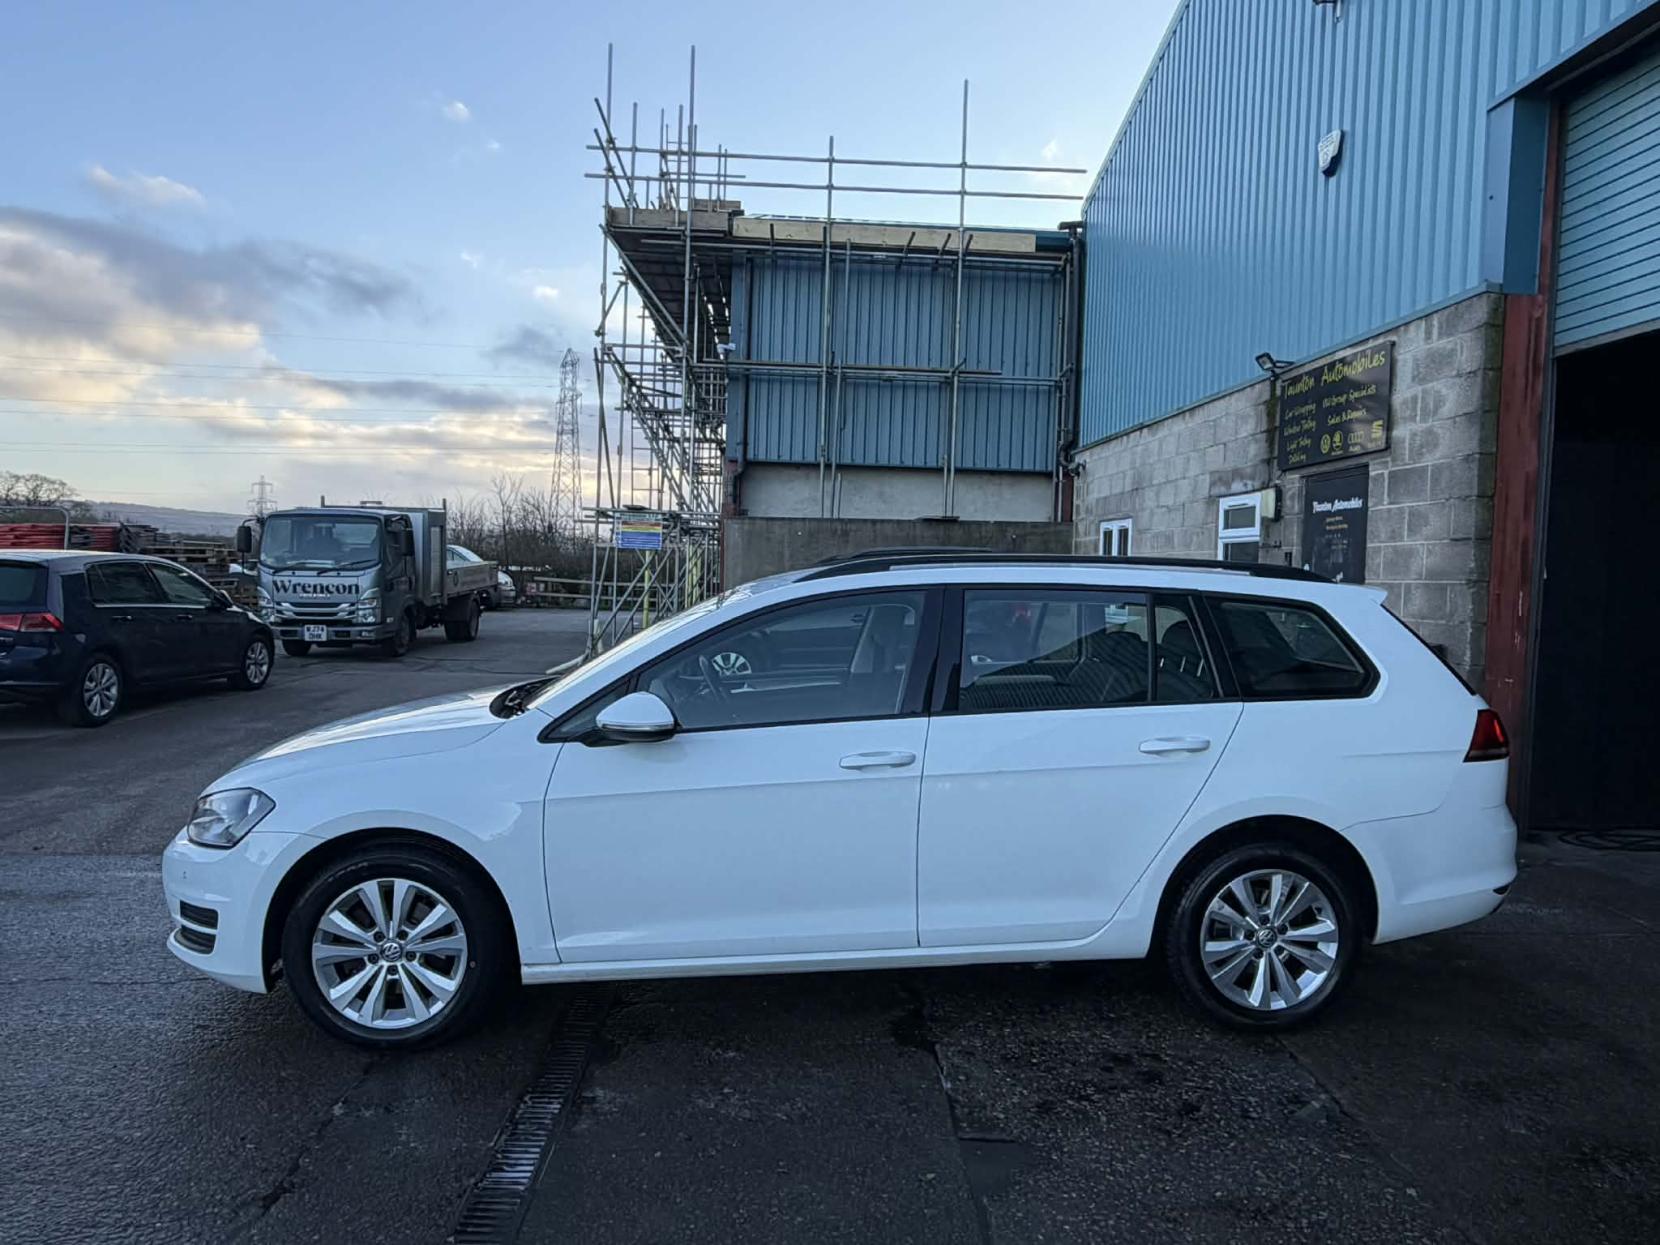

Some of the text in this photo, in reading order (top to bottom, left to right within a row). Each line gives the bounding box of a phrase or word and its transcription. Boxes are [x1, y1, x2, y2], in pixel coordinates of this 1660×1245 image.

[1285, 351, 1385, 398] Taunton Automobiles
[272, 579, 360, 594] Wrencon
